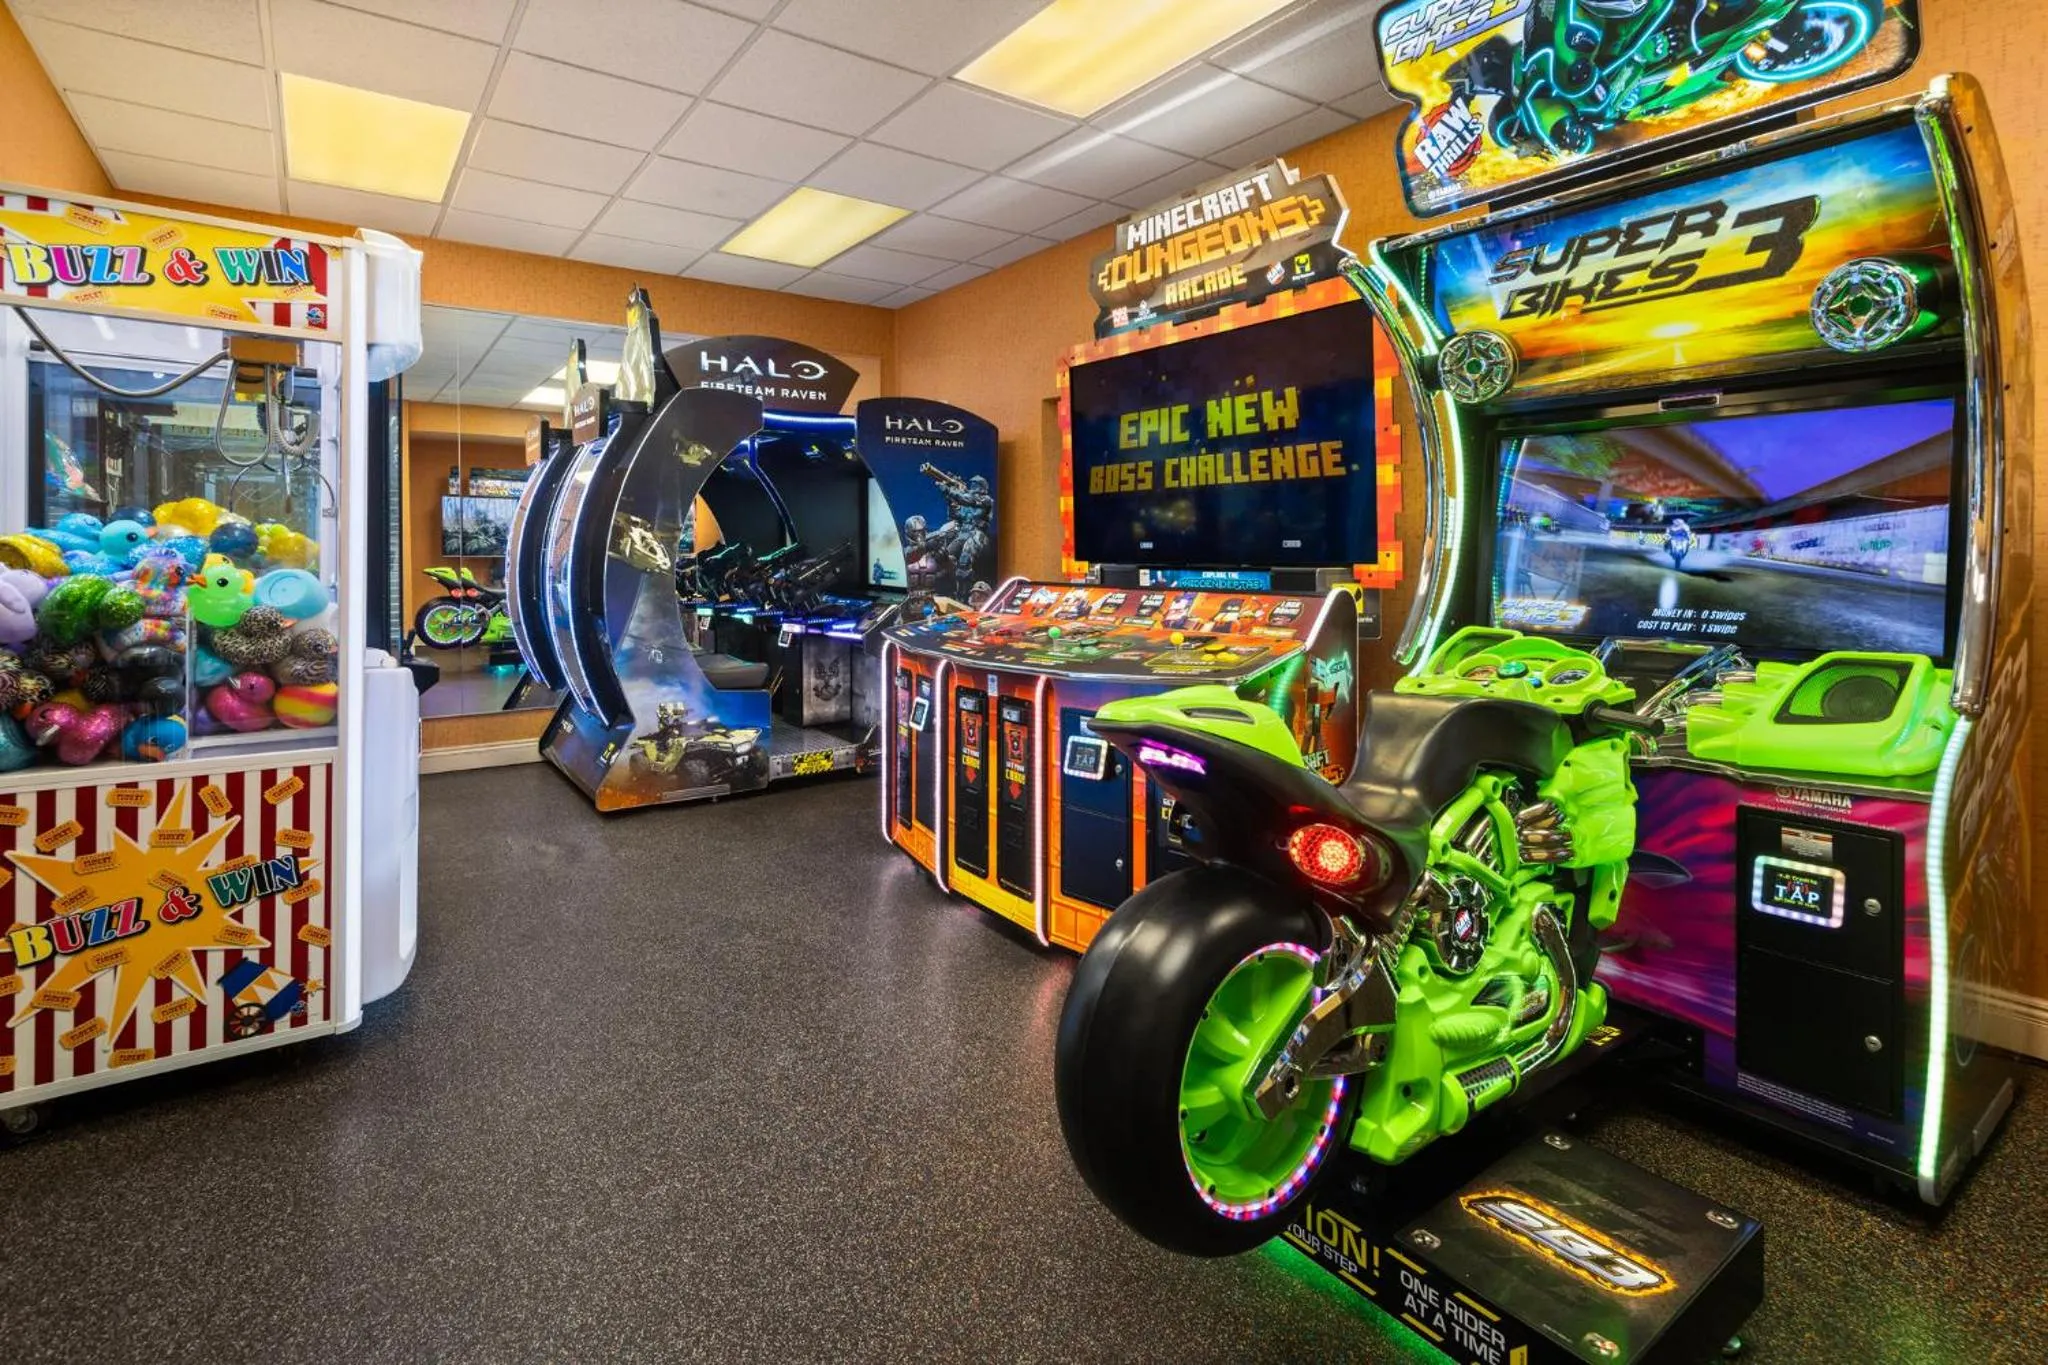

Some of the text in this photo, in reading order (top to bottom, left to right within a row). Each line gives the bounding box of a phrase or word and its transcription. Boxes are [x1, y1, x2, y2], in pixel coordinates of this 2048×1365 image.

[1414, 97, 1472, 169] RAW
[1429, 118, 1484, 179] THRILLS
[1127, 173, 1272, 250] MINECRAFT
[6, 243, 312, 286] BUZZ & WIN
[1110, 195, 1310, 292] DUNGEONS
[1487, 199, 1729, 285] SUPER
[1165, 262, 1248, 305] ARCADE
[1500, 249, 1707, 320] BIKES
[701, 350, 829, 380] HALO
[781, 388, 827, 401] RAVEN
[1118, 386, 1300, 450] EPIC NEW
[885, 415, 965, 434] HALO
[885, 436, 964, 448] FIRETEAM RAVEN
[1089, 440, 1347, 495] BOSS CHALLENGE
[1637, 620, 1659, 630] COST
[1660, 621, 1671, 630] TO
[1651, 608, 1682, 618] MONEY
[1793, 788, 1852, 808] YAMAHA
[9, 854, 301, 968] BUZZ & WIN
[1775, 884, 1820, 904] TAP
[1305, 1203, 1380, 1278] ION!
[1323, 1244, 1358, 1273] STEP
[1400, 1269, 1439, 1308] ONE
[1445, 1297, 1505, 1352] RIDER
[1404, 1293, 1429, 1319] AT
[1432, 1311, 1447, 1333] A
[1451, 1322, 1501, 1365] TIME
